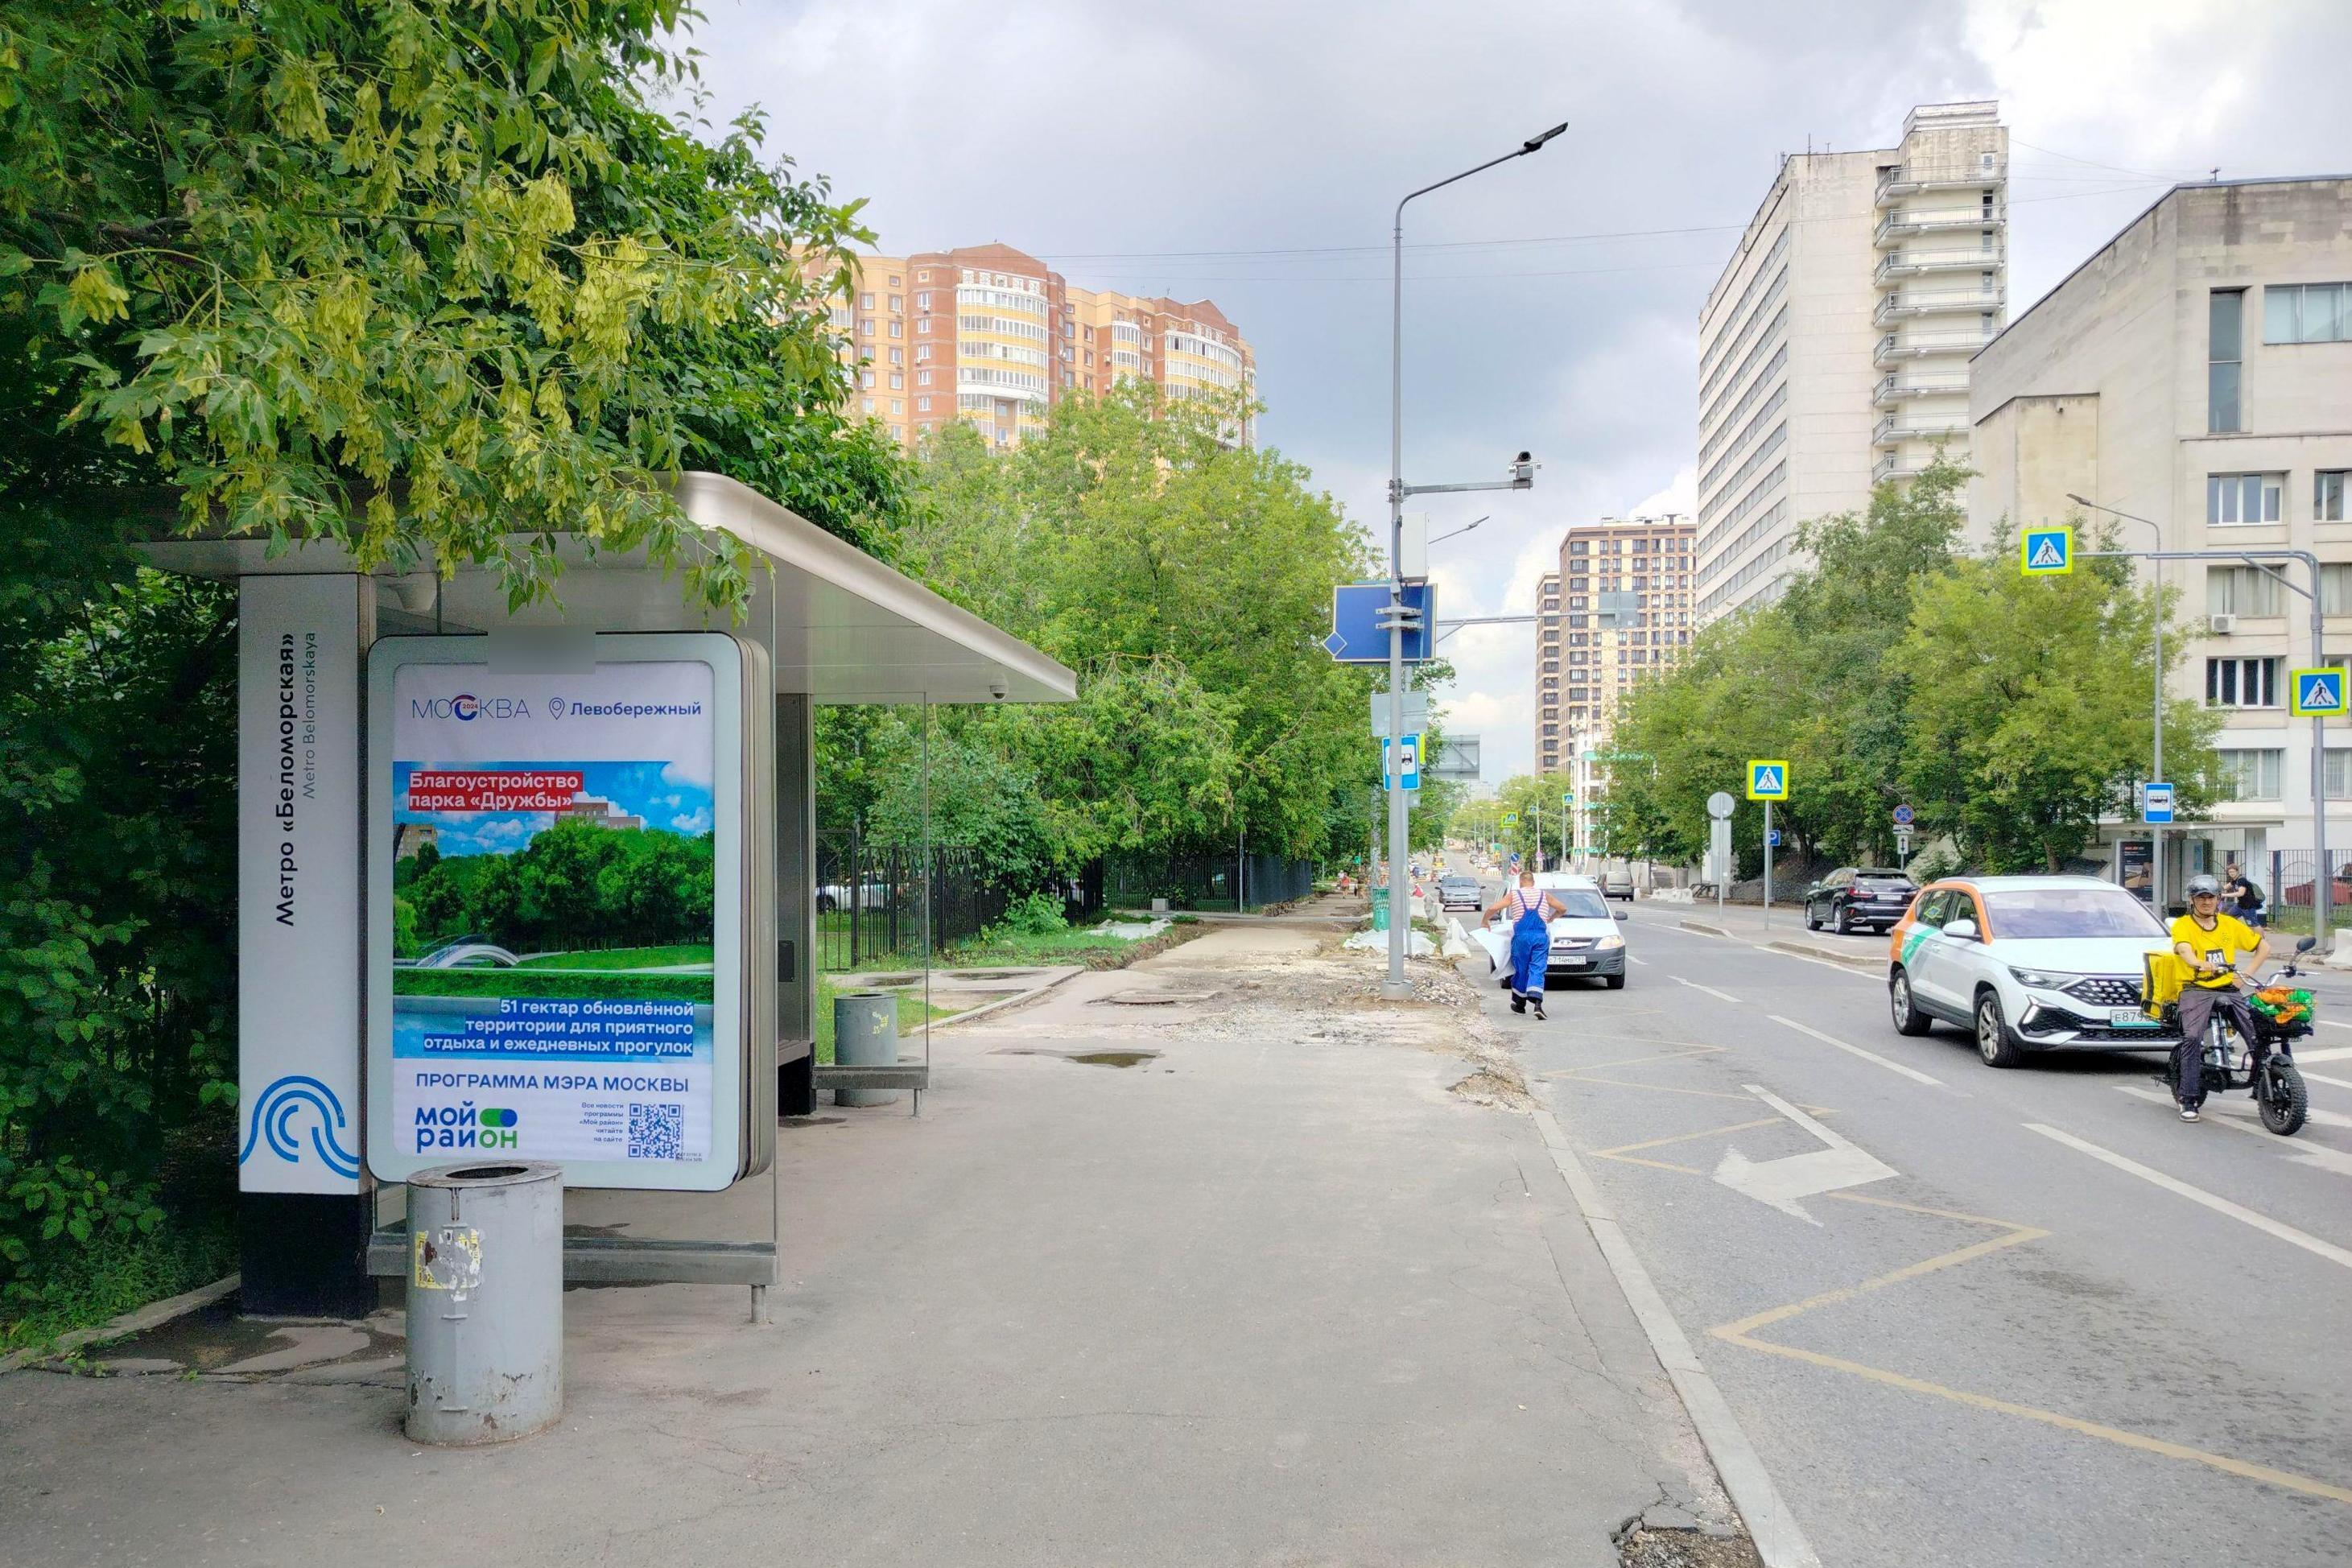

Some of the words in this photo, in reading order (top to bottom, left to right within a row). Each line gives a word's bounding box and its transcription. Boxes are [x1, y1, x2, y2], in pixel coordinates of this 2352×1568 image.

[302, 632, 316, 745] Belomorskaya
[411, 694, 530, 720] МОСКВА
[571, 702, 701, 717] Левобережный
[275, 633, 298, 832] «Беломорская»
[303, 749, 316, 798] Metro
[409, 773, 579, 792] Благоустройство
[409, 795, 465, 811] парка
[470, 793, 572, 811] «Дружбы»
[276, 842, 298, 926] Метро
[500, 1000, 518, 1013] 51
[522, 1003, 578, 1017] гектар
[583, 1001, 694, 1017] обновлённой
[465, 1021, 566, 1035] территории
[570, 1023, 600, 1036] для
[605, 1022, 693, 1037] приятного
[424, 1038, 485, 1052] отдыха
[490, 1041, 500, 1050] и
[504, 1039, 609, 1054] ежедневных
[615, 1041, 692, 1056] прогулок
[415, 1074, 538, 1090] ПРОГРАММА
[543, 1076, 598, 1090] МЭРА
[603, 1077, 689, 1092] МОСКВЫ
[599, 1119, 623, 1127] район»
